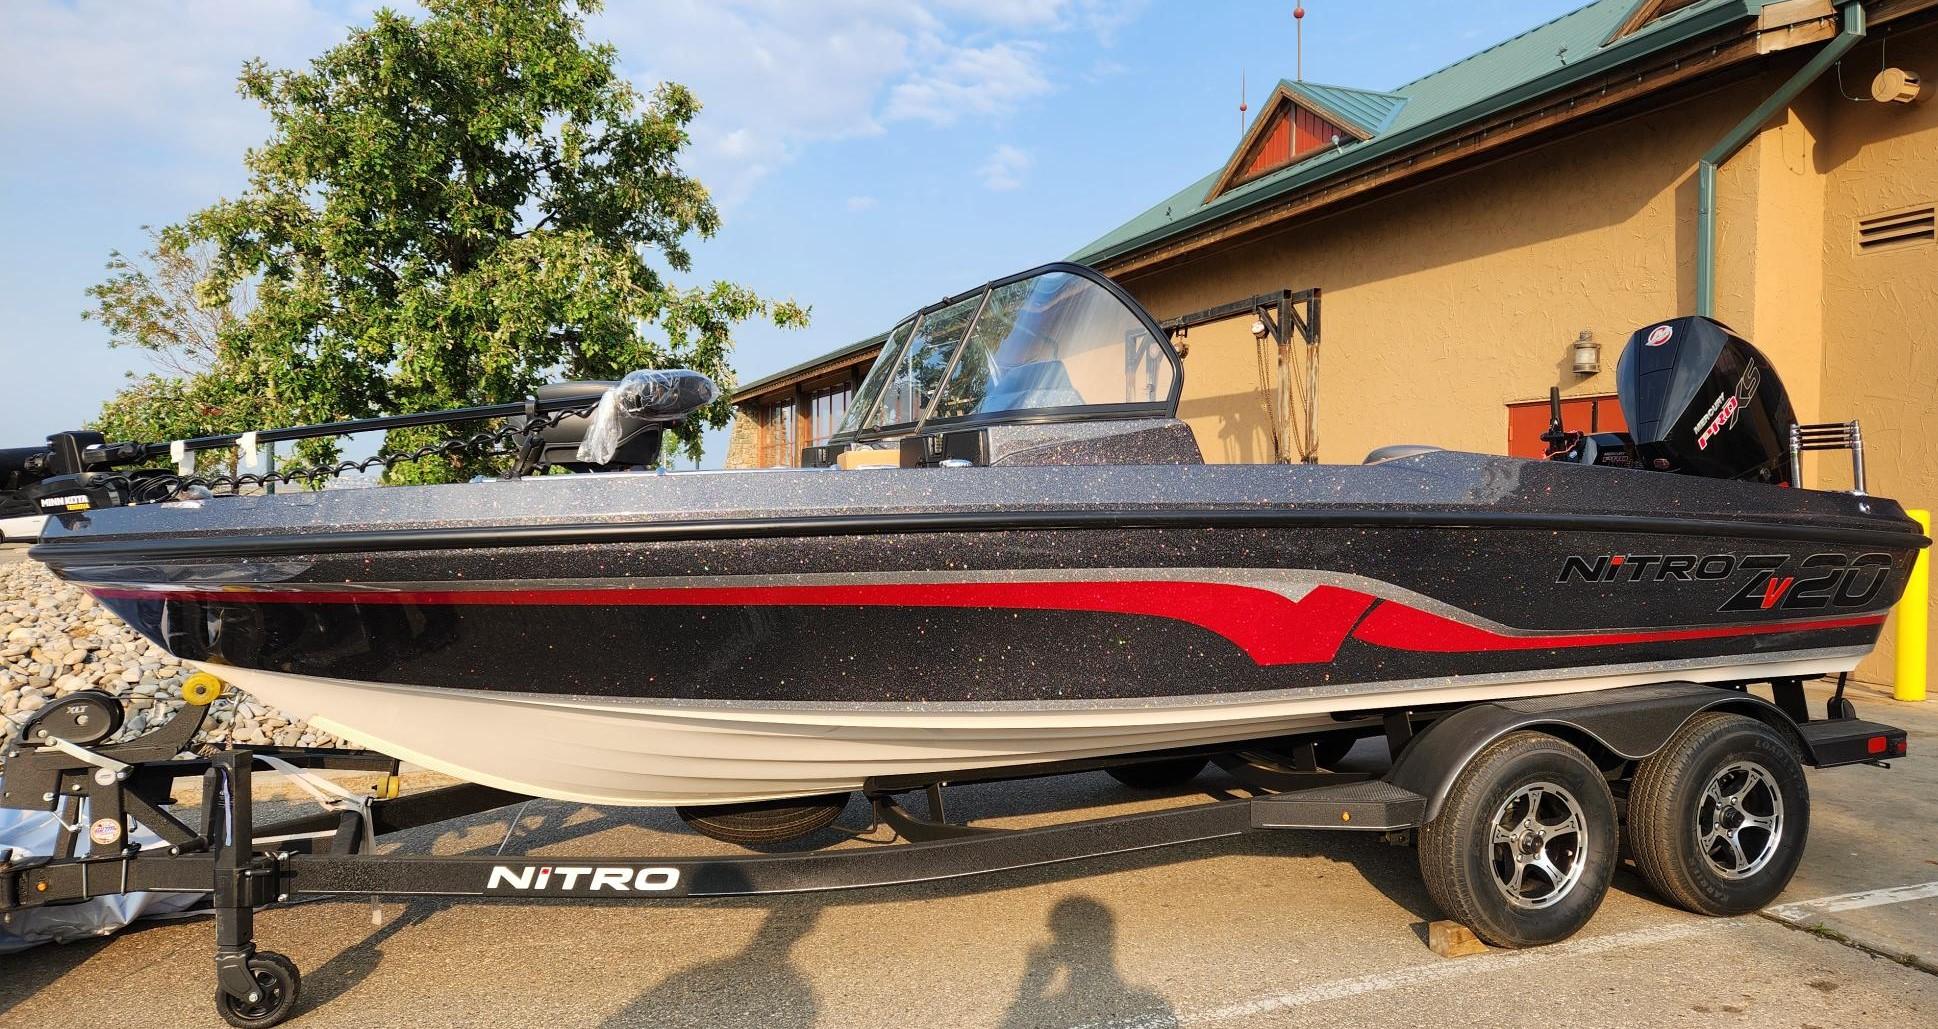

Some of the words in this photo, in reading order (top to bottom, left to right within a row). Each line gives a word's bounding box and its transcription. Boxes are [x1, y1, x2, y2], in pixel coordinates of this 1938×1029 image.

[1693, 391, 1725, 435] MERCURY
[1698, 395, 1738, 450] PRO
[40, 497, 64, 508] MINN
[64, 494, 89, 505] KOTA
[1555, 554, 1737, 584] NITRO
[66, 704, 89, 714] XLT
[486, 865, 681, 891] NITRO
